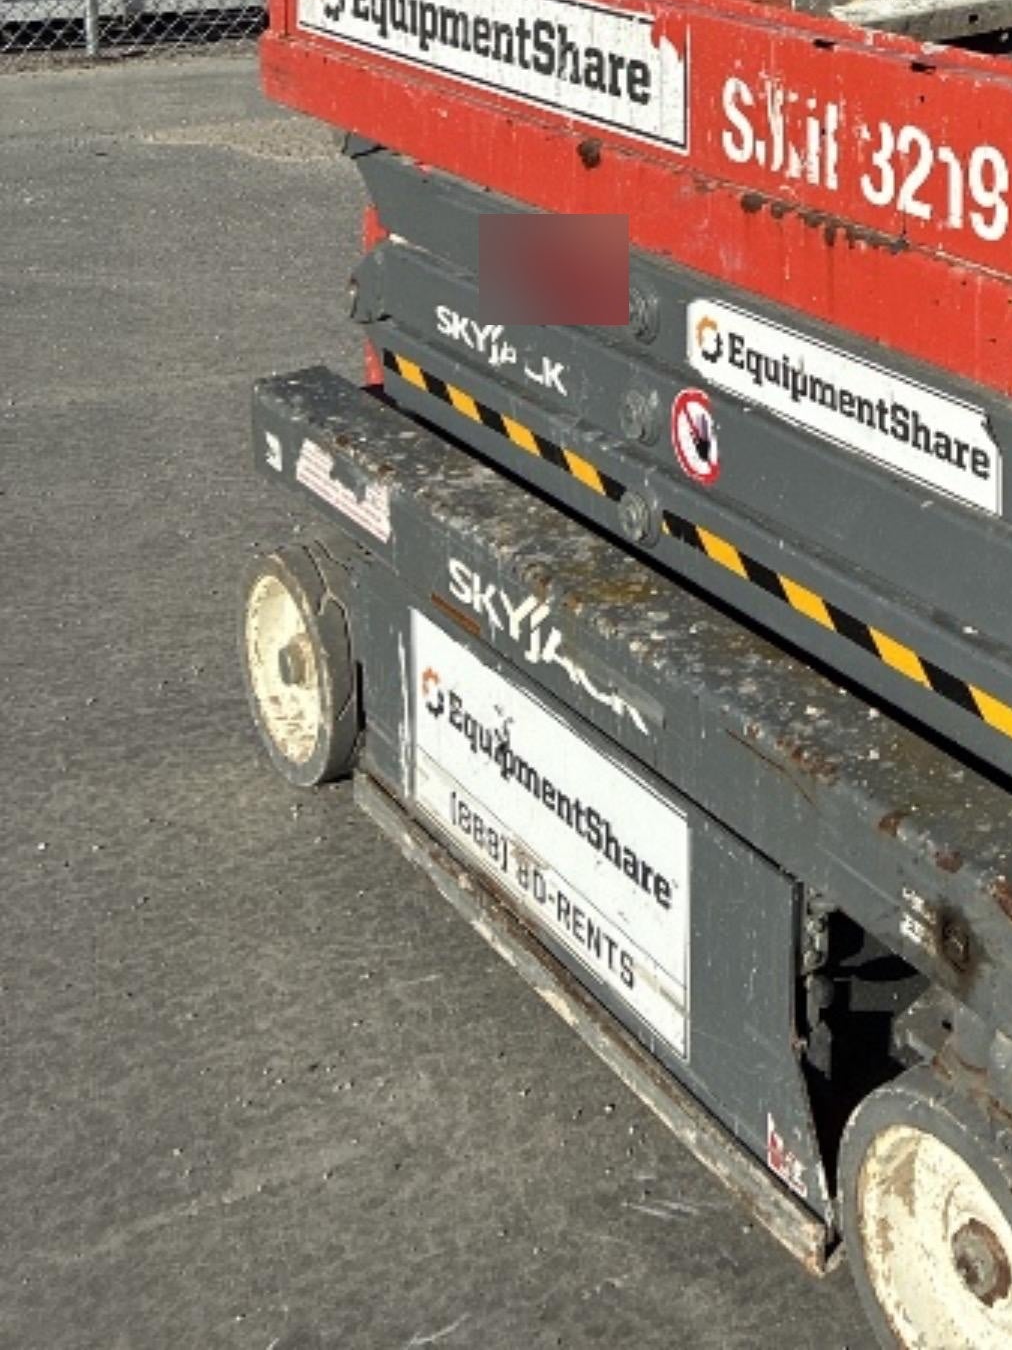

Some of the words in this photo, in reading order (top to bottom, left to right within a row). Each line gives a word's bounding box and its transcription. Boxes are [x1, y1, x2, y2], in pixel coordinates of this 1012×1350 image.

[860, 121, 1010, 242] 3219
[728, 332, 991, 480] EquipmentShare
[449, 689, 673, 911] EquipmentShare
